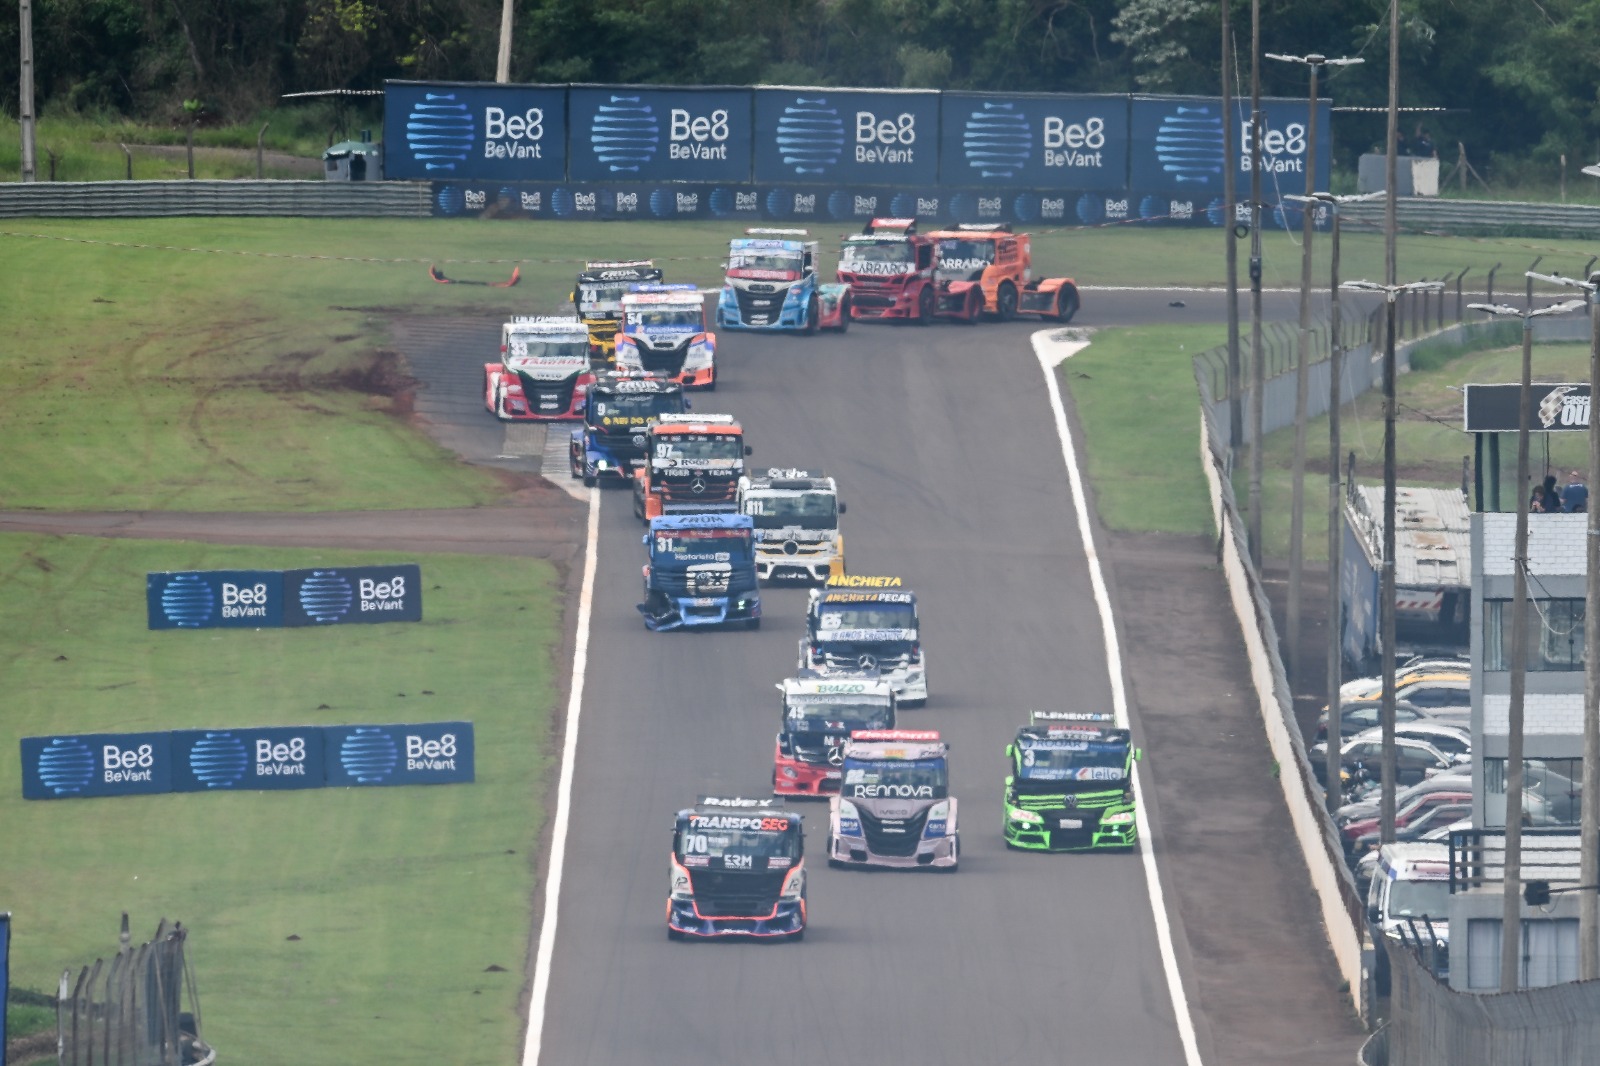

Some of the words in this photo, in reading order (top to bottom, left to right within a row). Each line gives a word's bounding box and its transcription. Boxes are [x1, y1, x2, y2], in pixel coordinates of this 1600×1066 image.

[485, 107, 544, 140] Be8
[670, 108, 728, 141] Be8
[856, 111, 916, 144] Be8
[1044, 116, 1105, 149] Be8
[484, 141, 542, 159] BeVant
[670, 143, 727, 160] BeVant
[856, 145, 914, 163] BeVant
[1044, 150, 1102, 168] BeVant
[1240, 156, 1302, 173] BVant
[852, 260, 908, 274] CARRARO
[628, 312, 642, 324] 54
[598, 402, 606, 416] 9
[656, 444, 673, 458] 97
[658, 537, 672, 552] 31
[360, 576, 404, 600] Be8
[826, 576, 902, 586] ANCHIETA
[222, 583, 266, 605] Be8
[222, 605, 266, 618] BeVant
[361, 600, 404, 612] BeVant
[816, 684, 864, 693] BRAZZO
[1034, 712, 1112, 720] ELEMENTAR
[256, 738, 306, 762] Be8
[406, 734, 456, 758] Be8
[104, 744, 153, 768] Be8
[407, 758, 456, 770] BeVant
[1024, 750, 1034, 766] 3
[104, 770, 152, 783] BeVant
[256, 763, 305, 776] BeVant
[1092, 770, 1120, 780] leilo
[688, 816, 788, 831] TRANSPOSEG
[686, 834, 708, 853] 70
